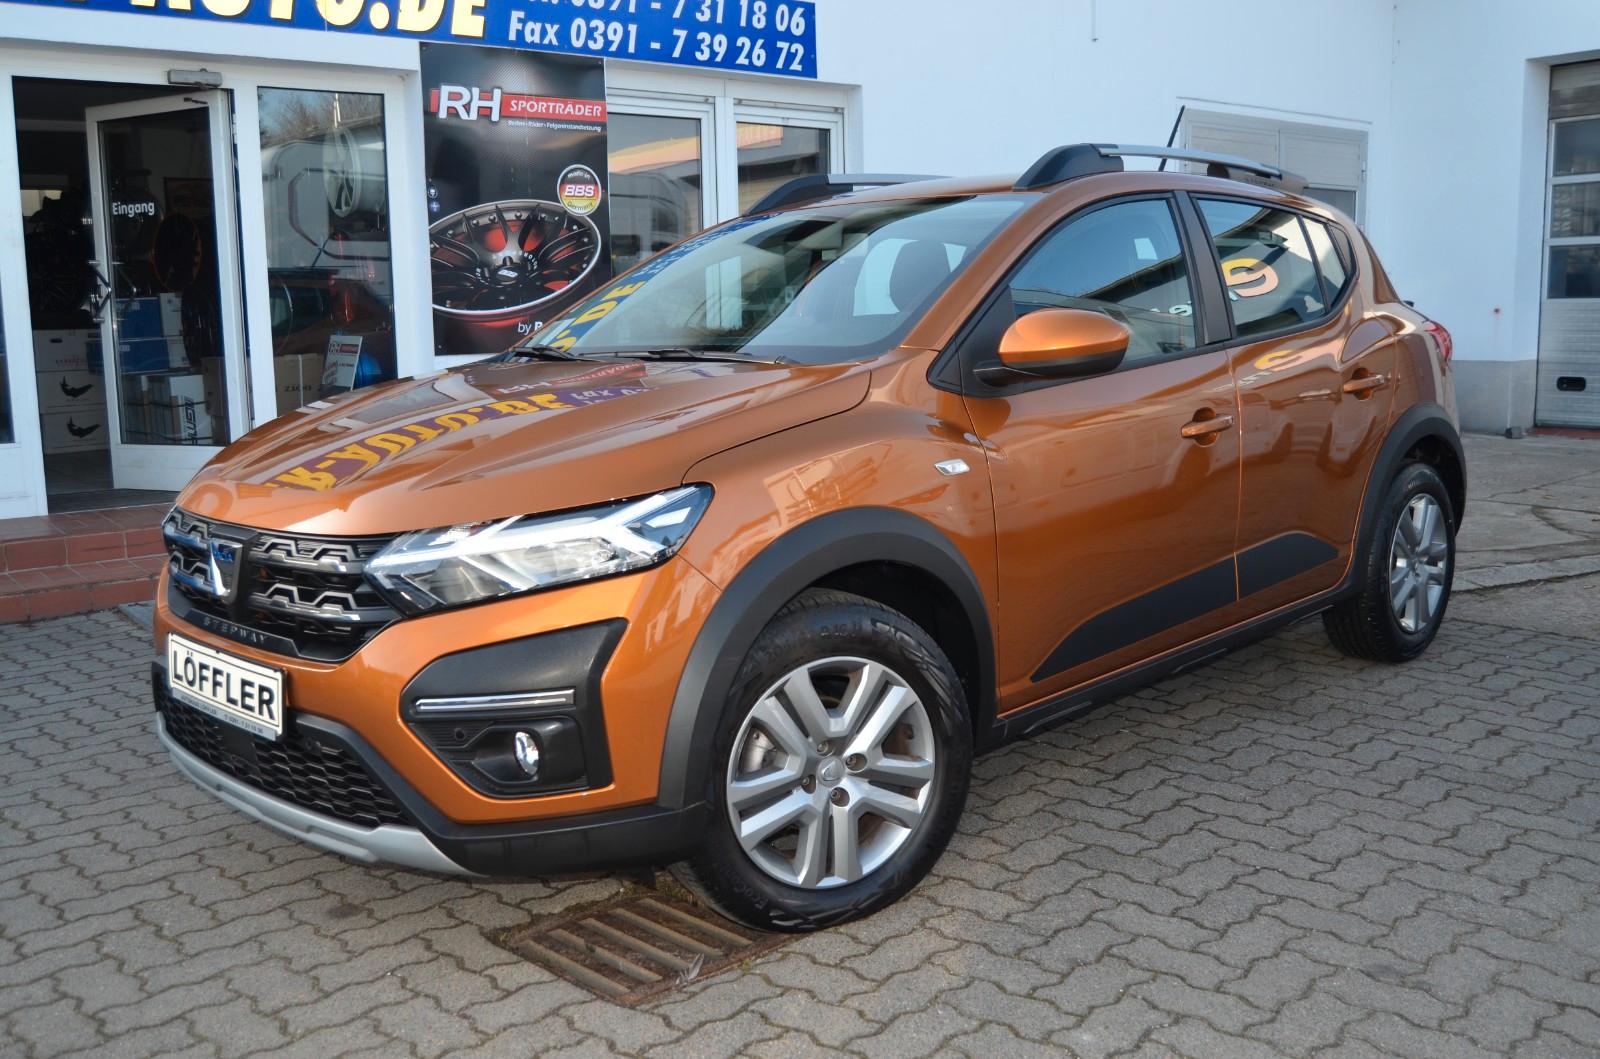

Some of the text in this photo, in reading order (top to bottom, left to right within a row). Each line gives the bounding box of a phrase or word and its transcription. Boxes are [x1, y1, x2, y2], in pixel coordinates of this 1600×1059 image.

[739, 0, 767, 29] 18
[775, 4, 806, 36] 06
[508, 10, 560, 46] Fax
[570, 17, 638, 54] 0391
[672, 29, 688, 58] 7
[695, 31, 728, 62] 39
[735, 36, 767, 67] 26
[775, 41, 805, 72] 72
[438, 85, 602, 122] RH SPORTRÄDER
[565, 184, 595, 197] BBS
[112, 201, 155, 218] Eingang
[517, 321, 533, 336] by
[173, 650, 276, 721] LÖFFLER
